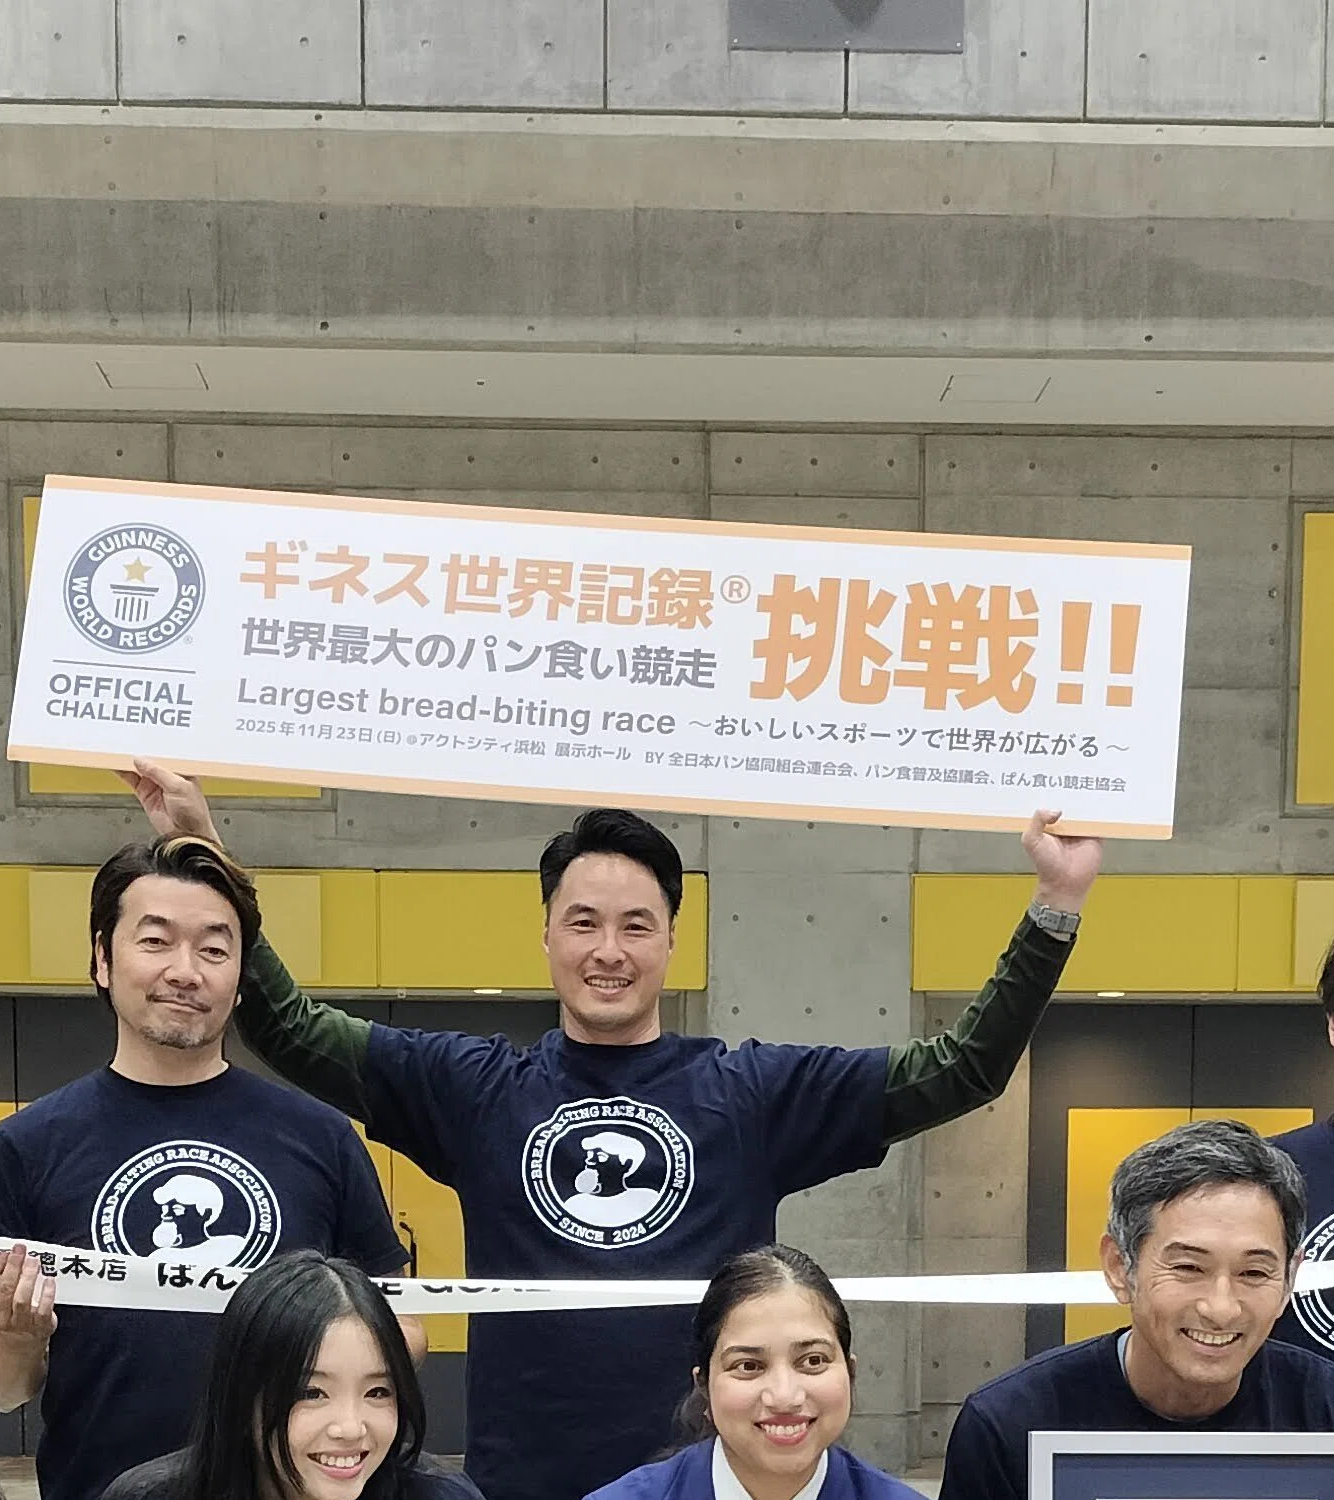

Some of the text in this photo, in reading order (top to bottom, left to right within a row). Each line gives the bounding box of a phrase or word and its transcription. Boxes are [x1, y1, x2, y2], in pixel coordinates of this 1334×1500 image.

[88, 530, 190, 568] GUINNESS
[71, 576, 197, 648] WORLD RECORDS
[241, 618, 717, 689] 世界最大のパン食い競走
[46, 699, 192, 728] CHALLENGE
[49, 673, 193, 706] OFFICIAL
[237, 677, 676, 736] Largest bread-biting race
[644, 751, 664, 764] BY
[530, 1105, 687, 1190] BREAD-BITING RACE ASSOCIATION
[100, 1147, 273, 1245] BREAD-BITING RACE ASSOCIATION
[558, 1216, 647, 1243] SINCE 2024
